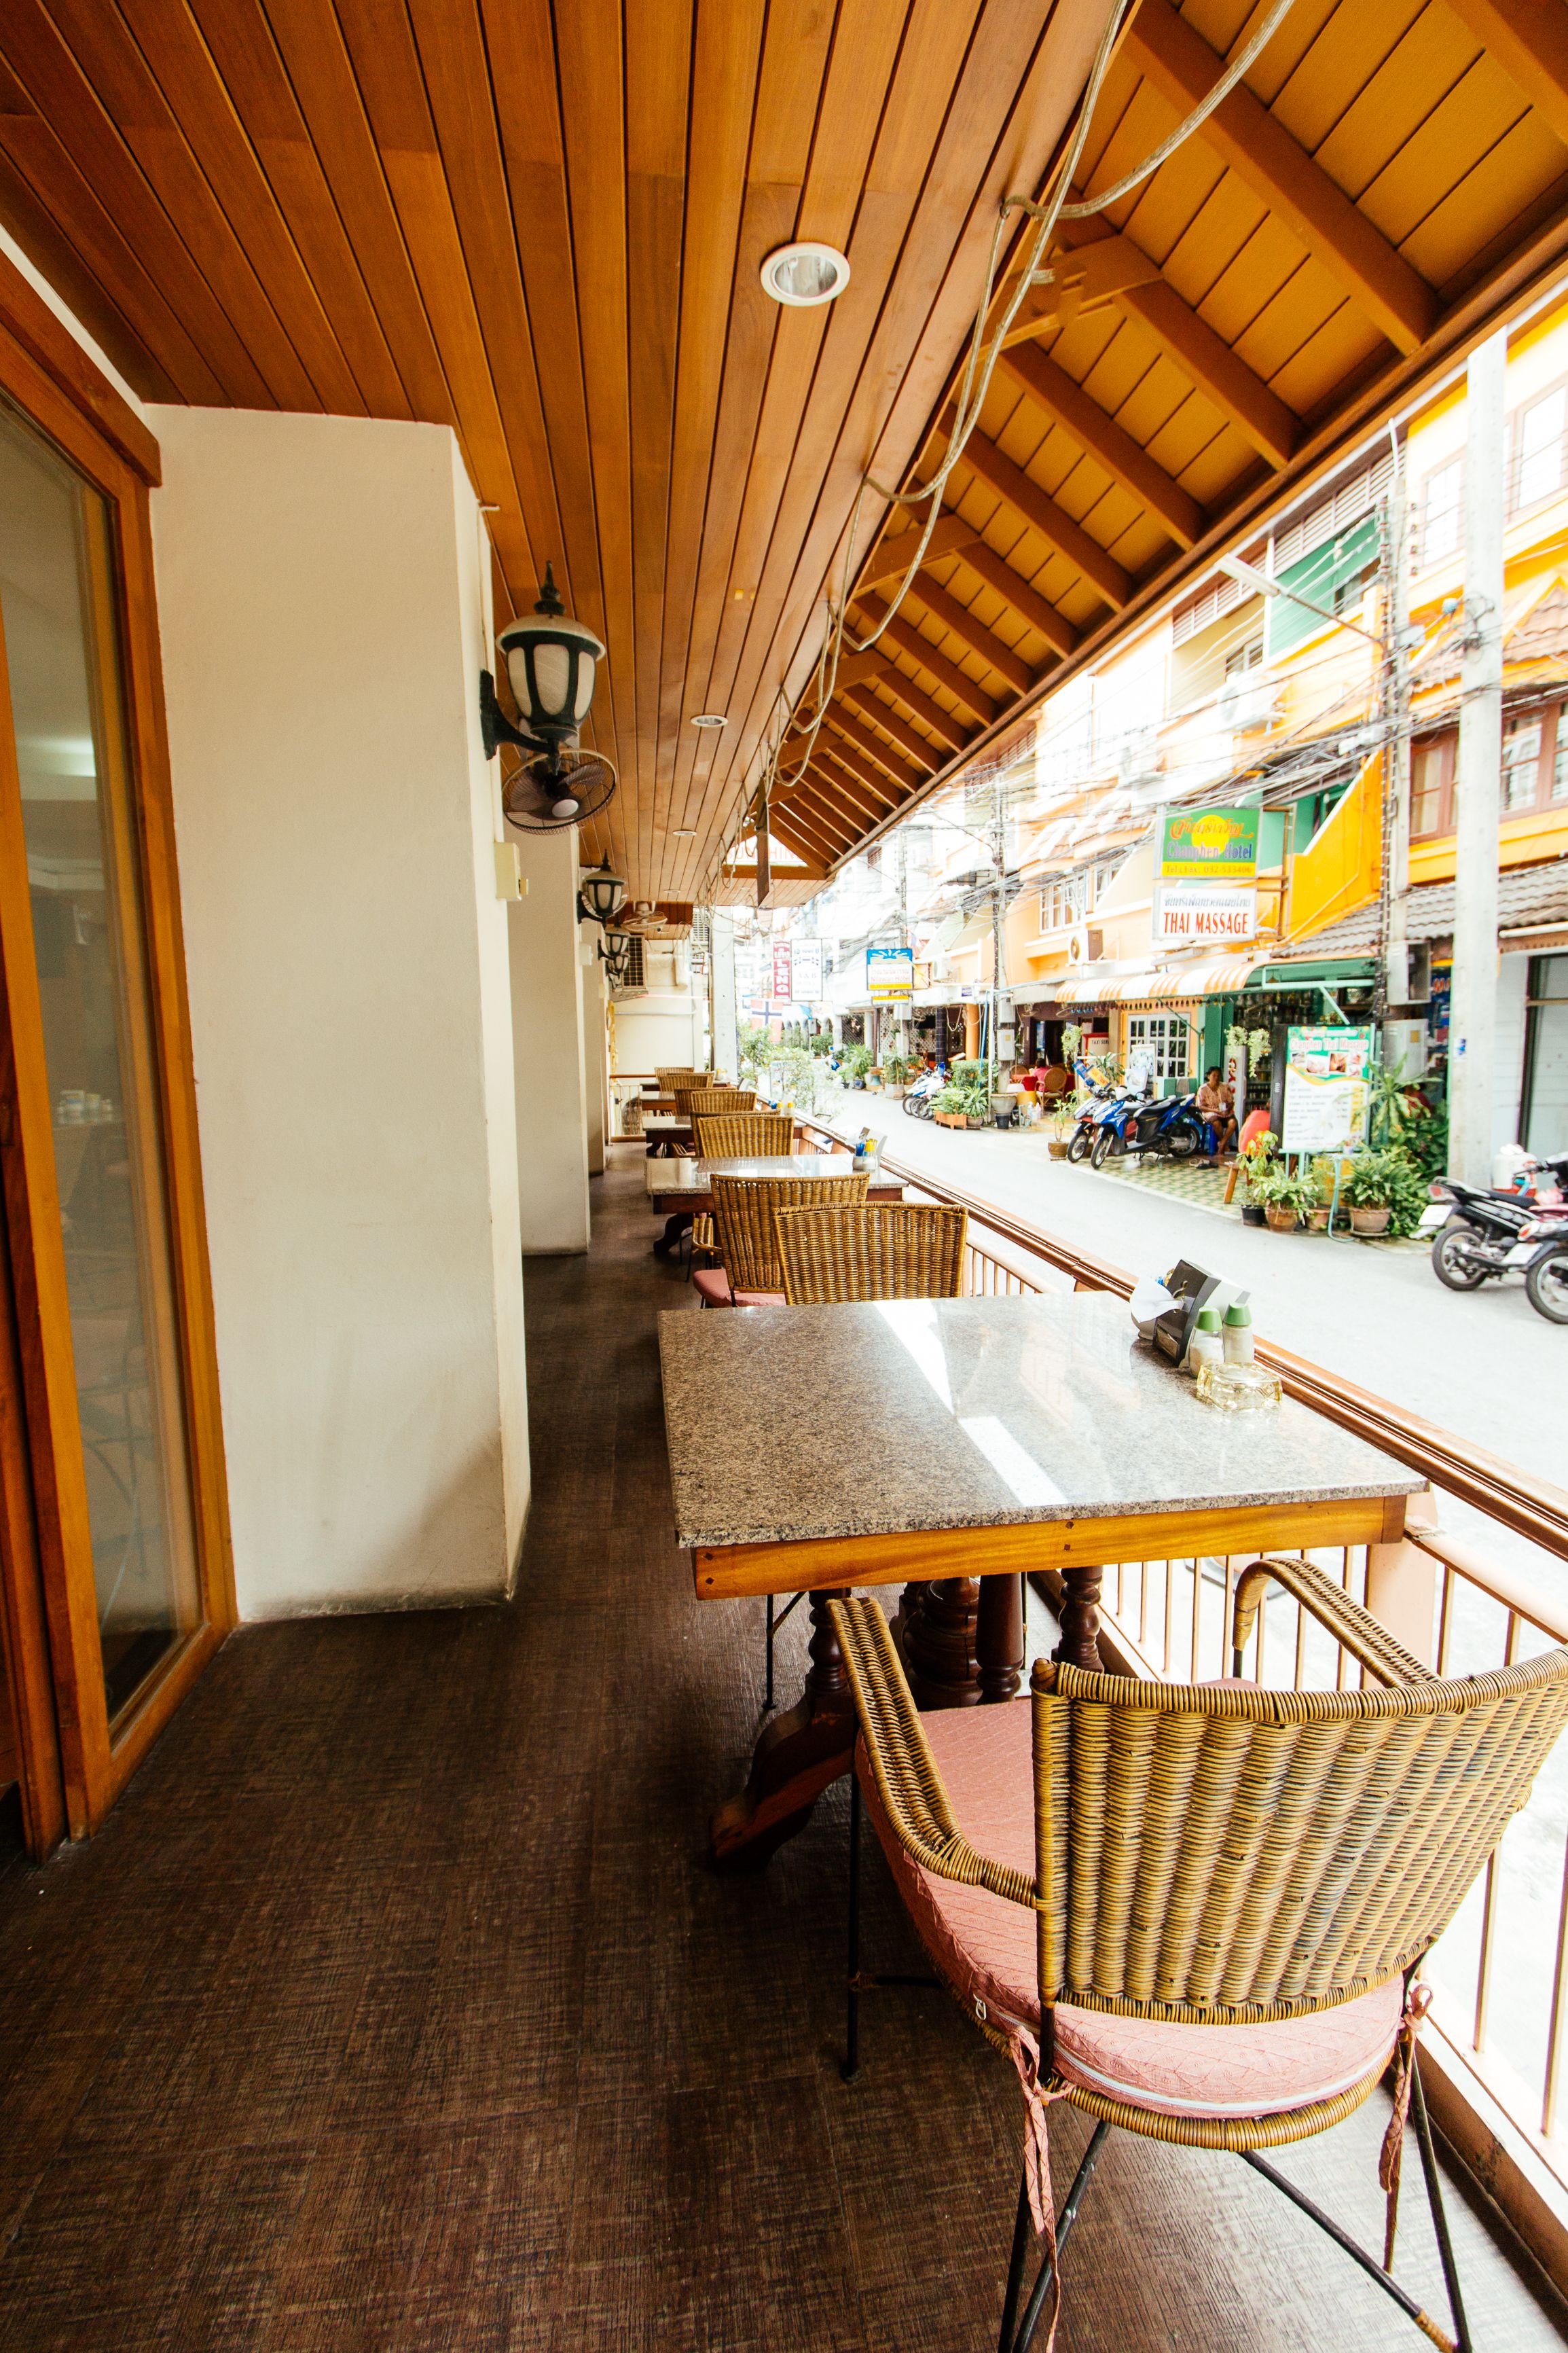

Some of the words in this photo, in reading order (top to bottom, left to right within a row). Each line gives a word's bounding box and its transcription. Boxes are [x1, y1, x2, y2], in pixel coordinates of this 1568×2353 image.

[1167, 842, 1220, 862] Chanphen
[1224, 842, 1252, 859] Hotel
[1164, 912, 1190, 934] THAI
[1195, 912, 1250, 935] MASSAGE
[1324, 1038, 1338, 1049] Thai
